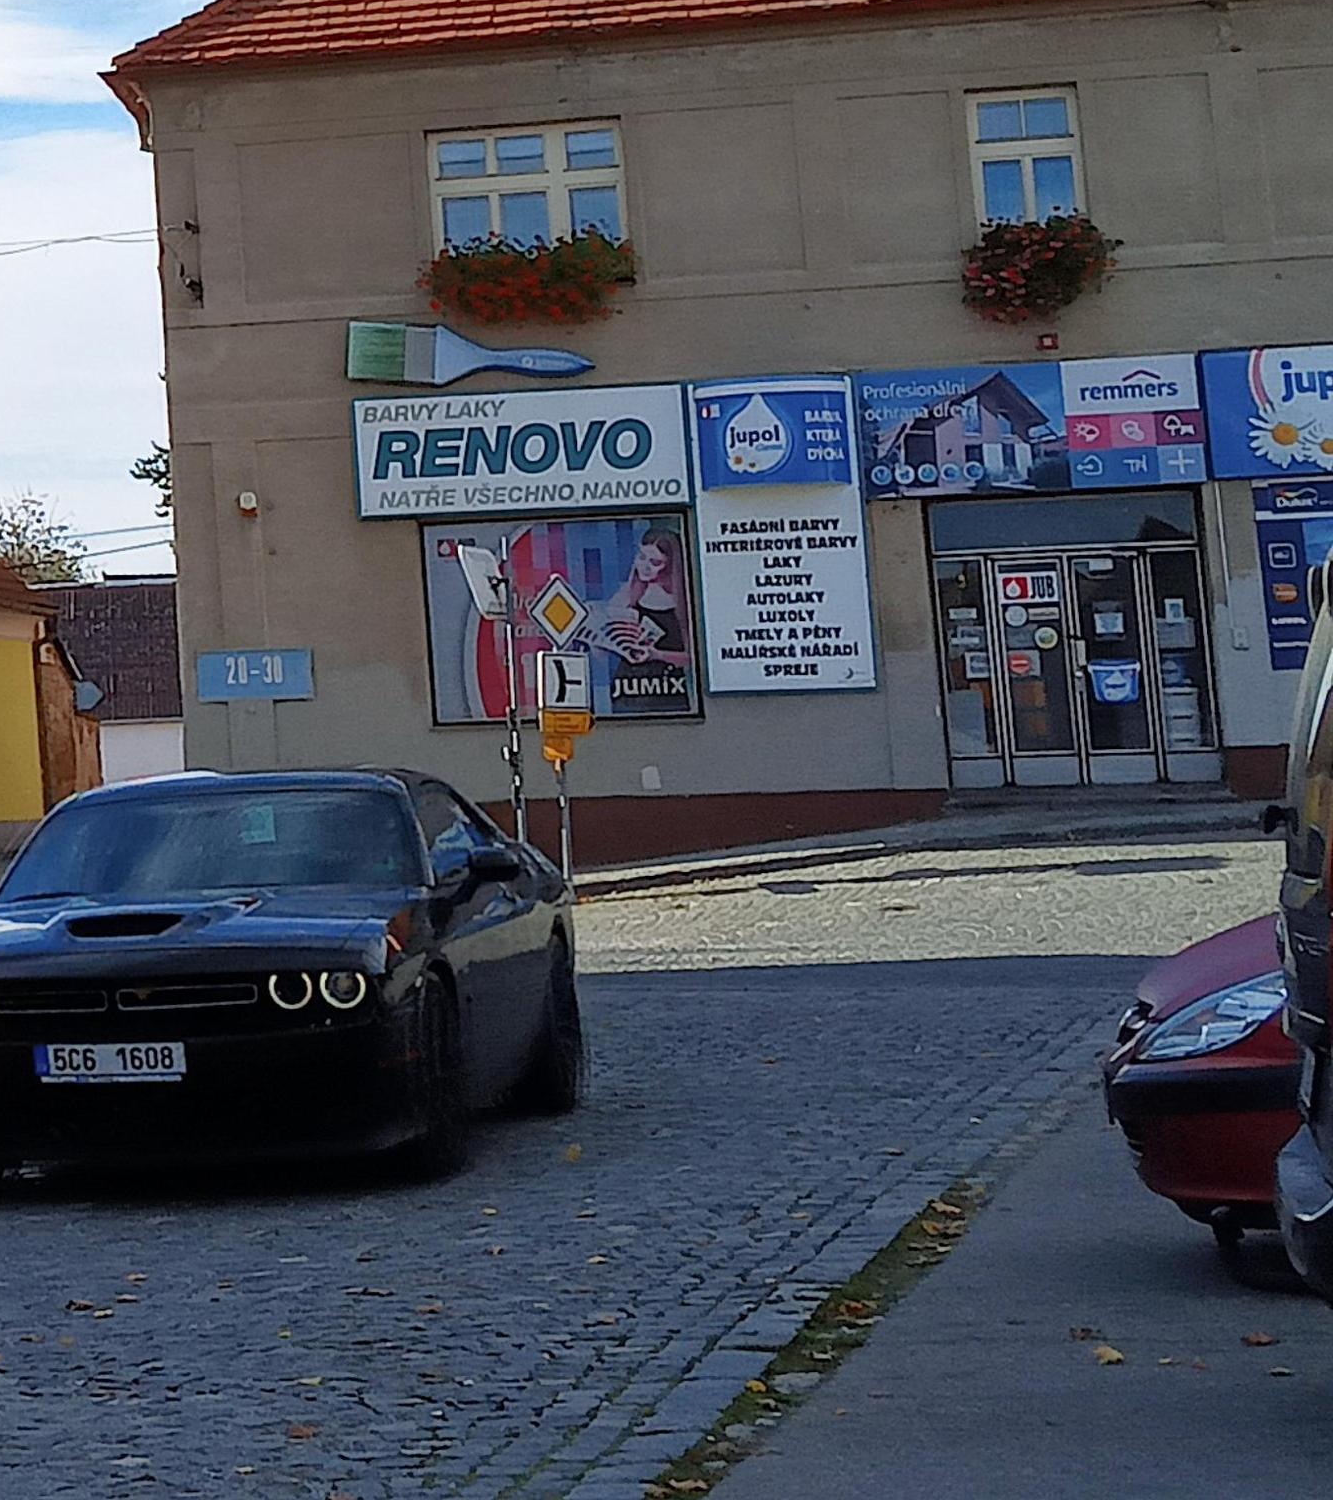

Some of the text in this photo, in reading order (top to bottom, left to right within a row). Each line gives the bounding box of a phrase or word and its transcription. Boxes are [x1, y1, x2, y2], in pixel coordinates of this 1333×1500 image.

[1079, 382, 1179, 401] remmers
[362, 400, 506, 424] BARVY LAKY
[864, 406, 929, 421] ochrana
[729, 424, 780, 449] jupol
[373, 418, 652, 480] RENOVO
[379, 478, 681, 509] NATŘE VŠECHNO NANOVO
[720, 518, 840, 535] FASÁDNÍ BARVY
[706, 535, 857, 553] INTERIÉROVÉ BARVY
[763, 556, 802, 568] LAKY
[755, 574, 813, 587] LAZURY
[1030, 575, 1055, 599] JUB
[747, 591, 825, 605] AUTOLAKY
[758, 610, 815, 623] LUXOLY
[735, 625, 842, 641] TMELY A PĚNY
[721, 641, 859, 659] MALÍŘSKÉ NÁŘADÍ
[226, 655, 283, 684] 20-30
[764, 663, 819, 676] SPREJE
[53, 1046, 174, 1071] 5C6 1608
